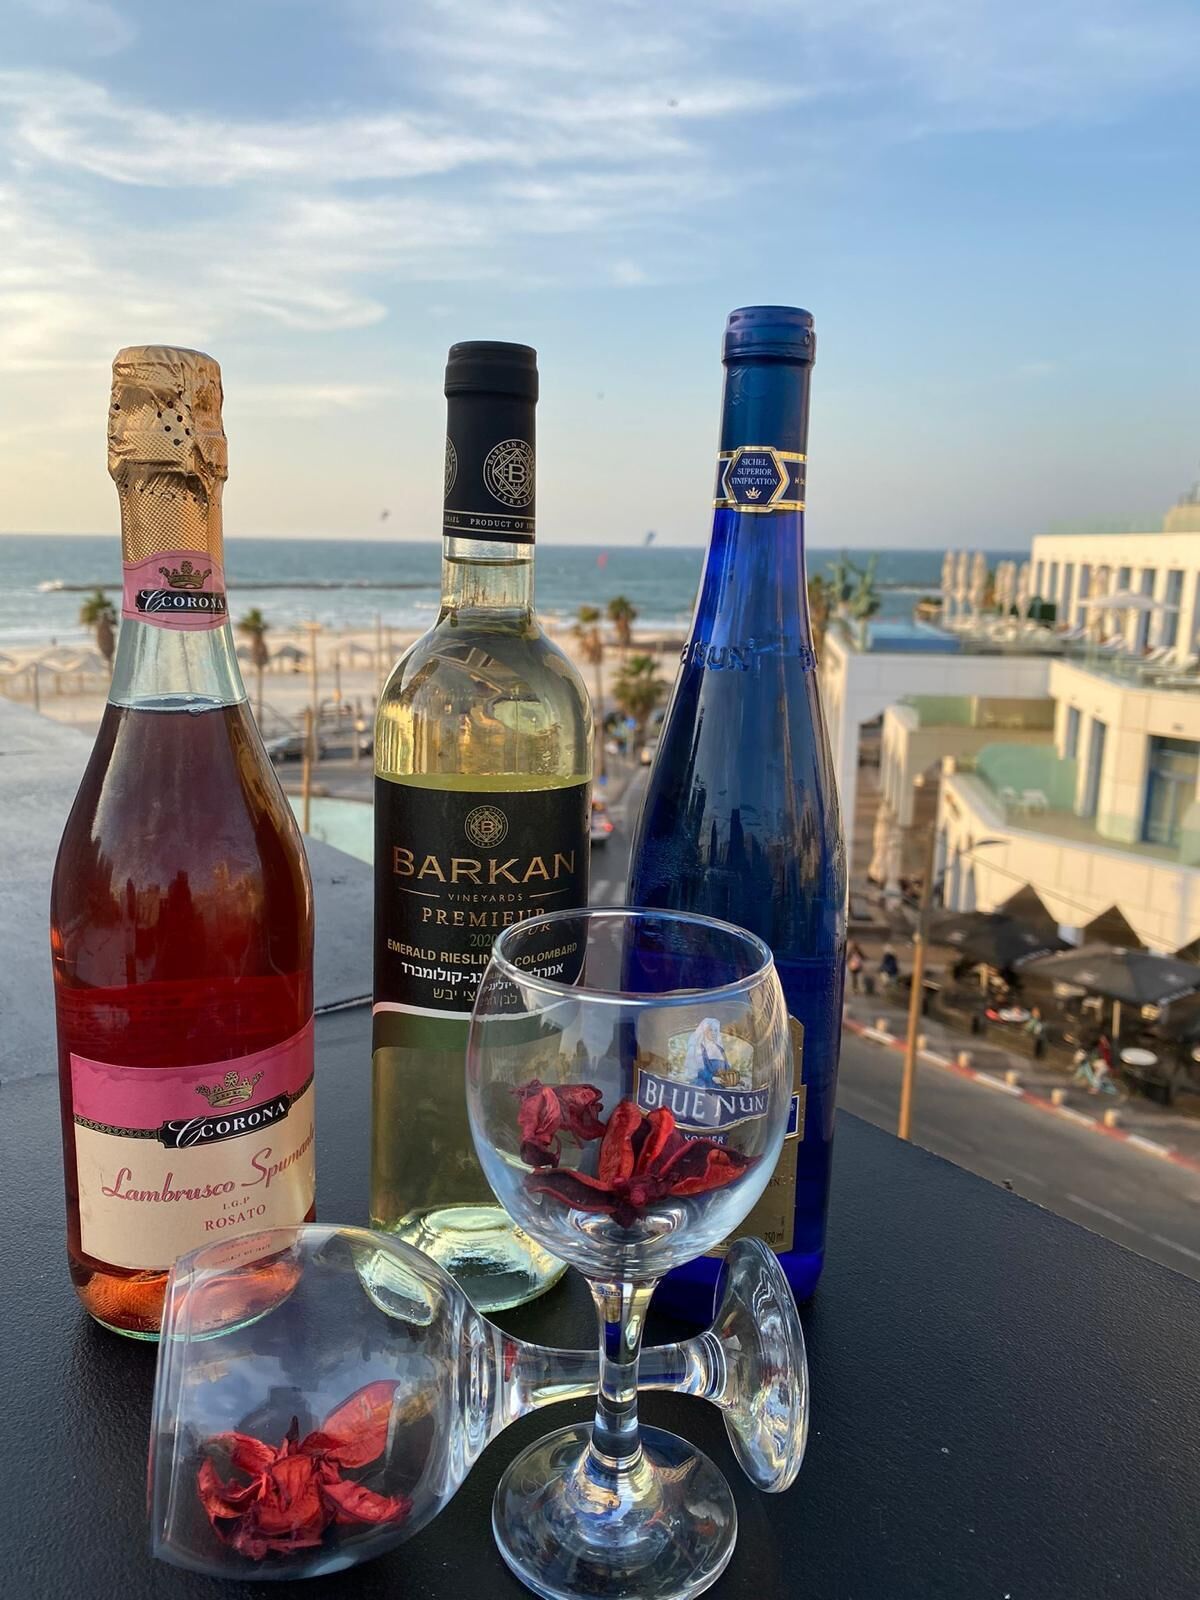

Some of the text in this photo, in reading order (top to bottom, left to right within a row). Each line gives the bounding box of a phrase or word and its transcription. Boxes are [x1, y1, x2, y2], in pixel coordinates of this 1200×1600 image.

[741, 458, 768, 466] SICHEL
[508, 463, 525, 483] B
[737, 467, 772, 476] SUPERIOR
[731, 477, 778, 485] VINIFICATION
[470, 518, 511, 528] PRODUCT
[480, 820, 496, 834] B
[392, 846, 576, 885] BARKAN
[447, 893, 523, 902] VINEYARDS
[387, 938, 578, 967] EMERALD RIESLIN COLOMBARD
[433, 987, 458, 1000] יבש
[715, 1095, 764, 1117] NUN
[101, 1167, 236, 1203] Lambrusco
[205, 1204, 266, 1231] ROSATO
